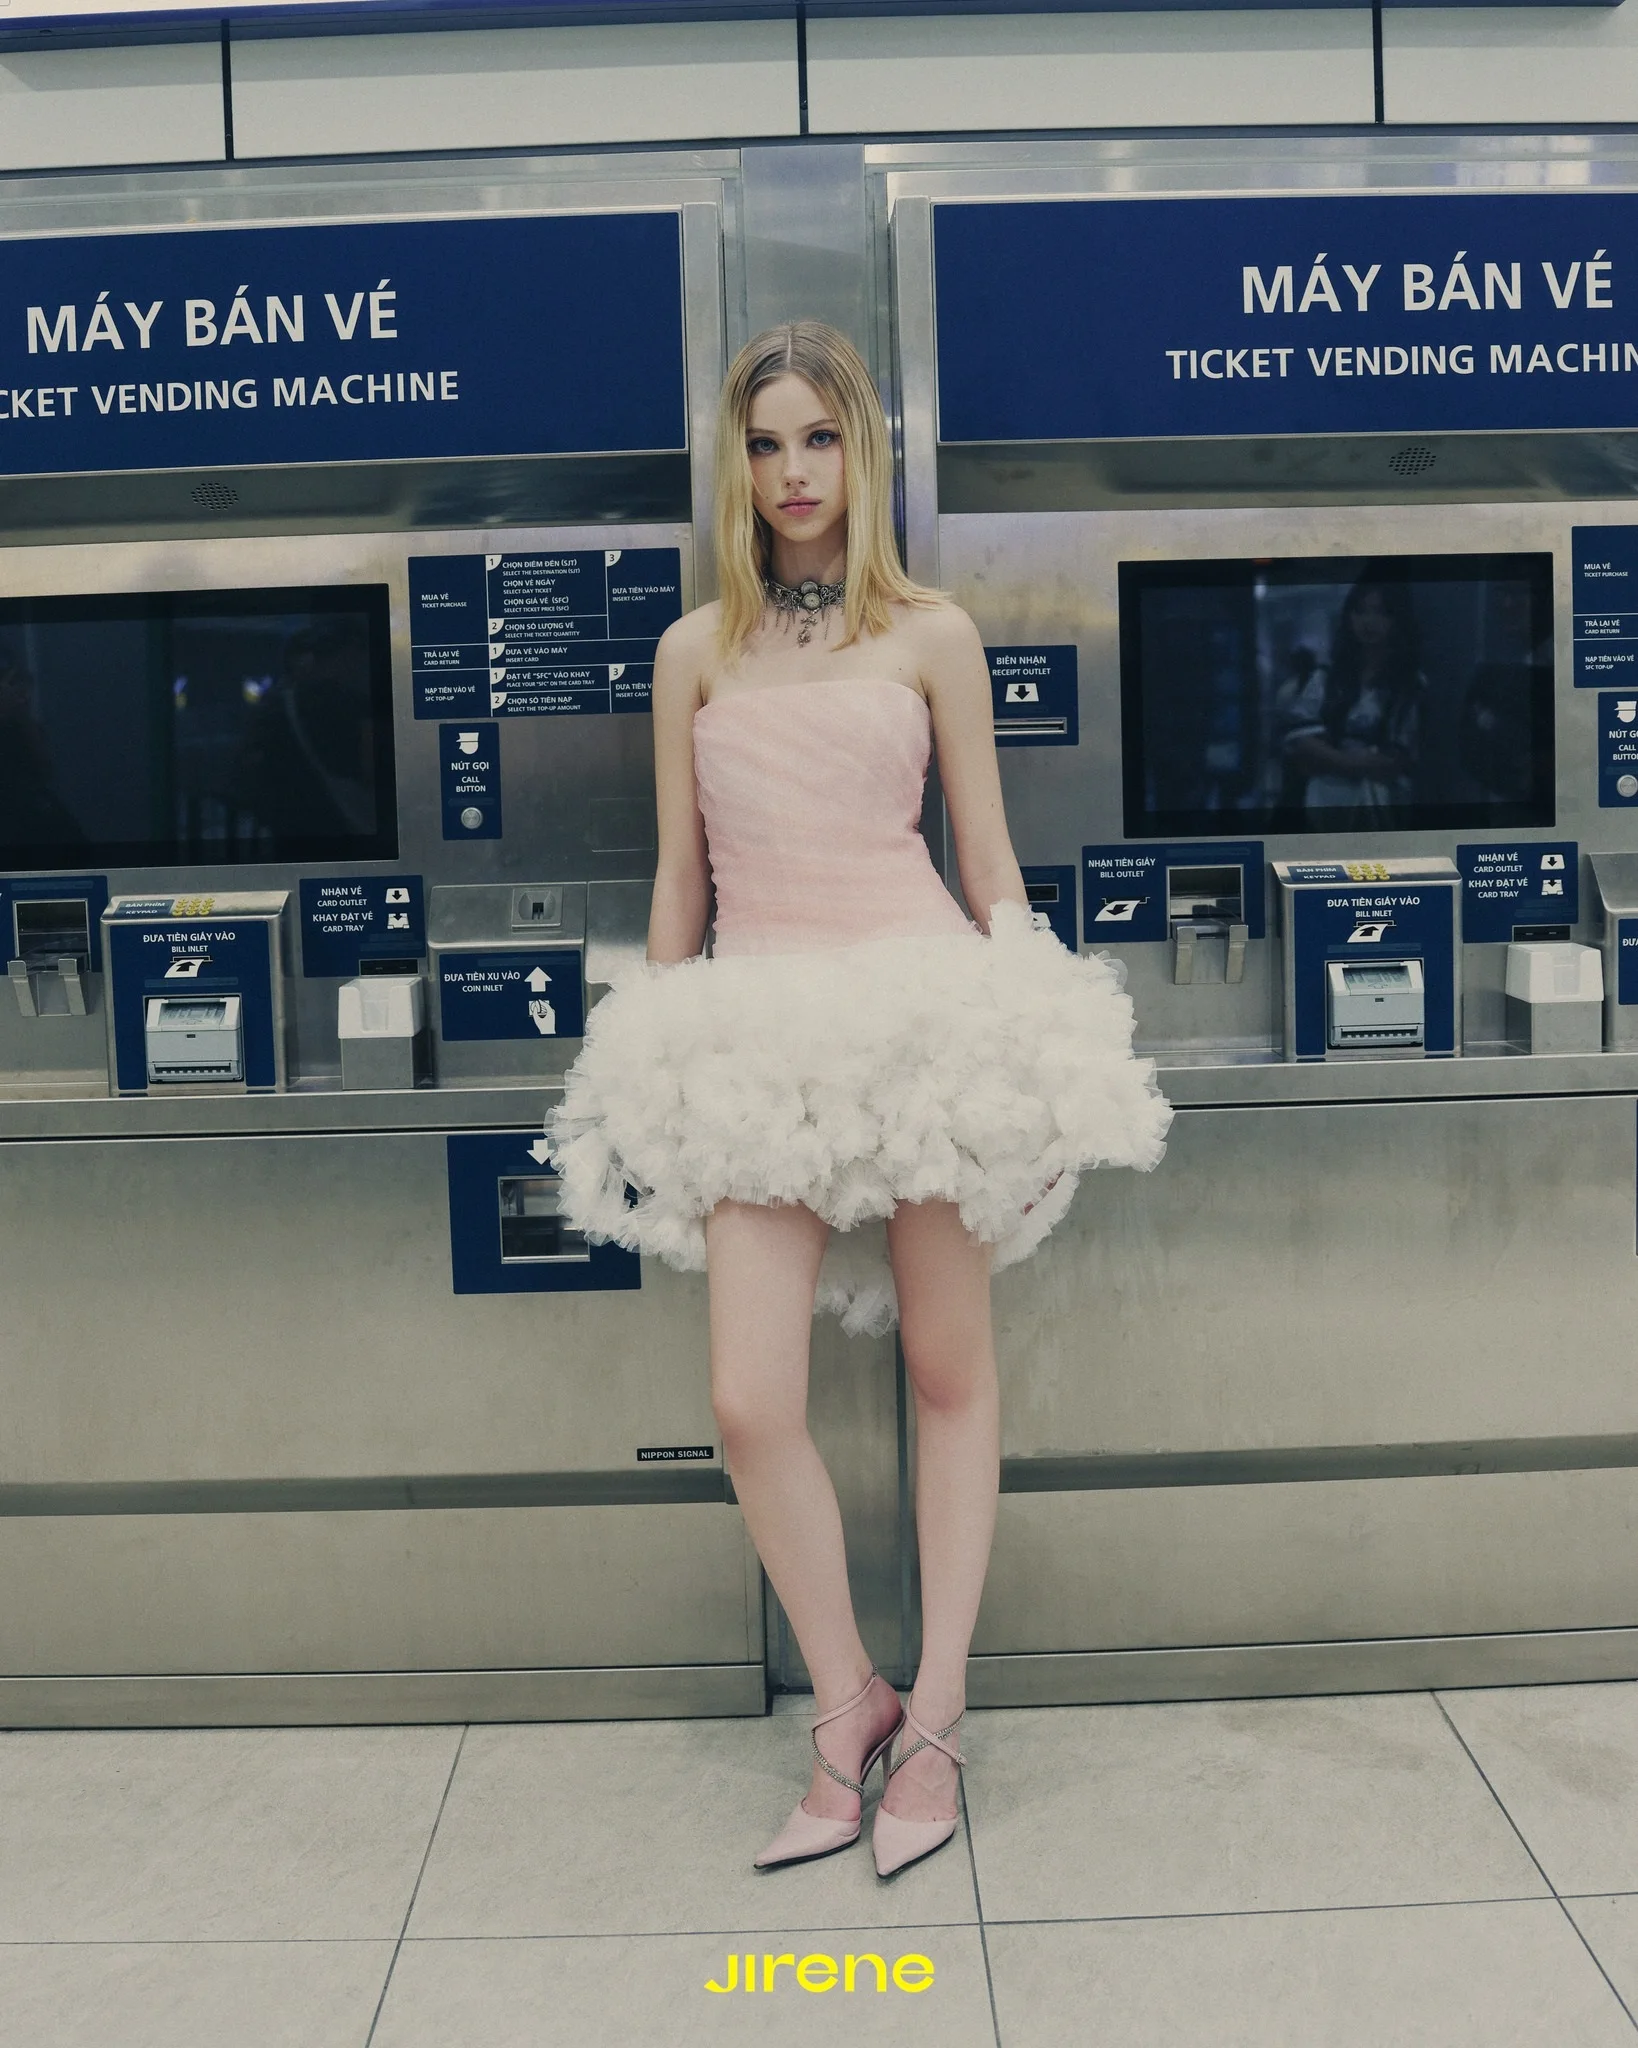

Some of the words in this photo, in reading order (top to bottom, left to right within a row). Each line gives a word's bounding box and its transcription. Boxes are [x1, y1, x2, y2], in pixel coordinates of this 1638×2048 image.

[1243, 253, 1381, 313] MÁY
[1404, 251, 1521, 310] BÁN
[1542, 249, 1612, 308] VÉ
[27, 291, 163, 353] MÁY
[185, 285, 304, 346] BÁN
[324, 279, 397, 340] VÉ
[1166, 349, 1294, 379] TICKET
[1307, 345, 1474, 376] VENDING
[91, 379, 257, 414] VENDING
[274, 371, 458, 406] MACHINE
[1609, 729, 1627, 738] NÚT
[451, 761, 470, 770] NÚT
[473, 762, 489, 771] GỌI
[1507, 852, 1518, 861] VÉ
[1496, 879, 1514, 888] ĐẠT
[1517, 877, 1528, 886] VÉ
[350, 886, 362, 895] VÉ
[1327, 899, 1349, 907] ĐƯA
[1399, 896, 1420, 905] VÀO
[341, 913, 359, 922] ĐẠT
[362, 911, 373, 920] VÉ
[143, 934, 164, 943] ĐƯA
[215, 931, 235, 940] VÀO
[1623, 938, 1638, 946] ĐƯ
[444, 972, 464, 982] ĐƯA
[501, 971, 520, 980] VÀO
